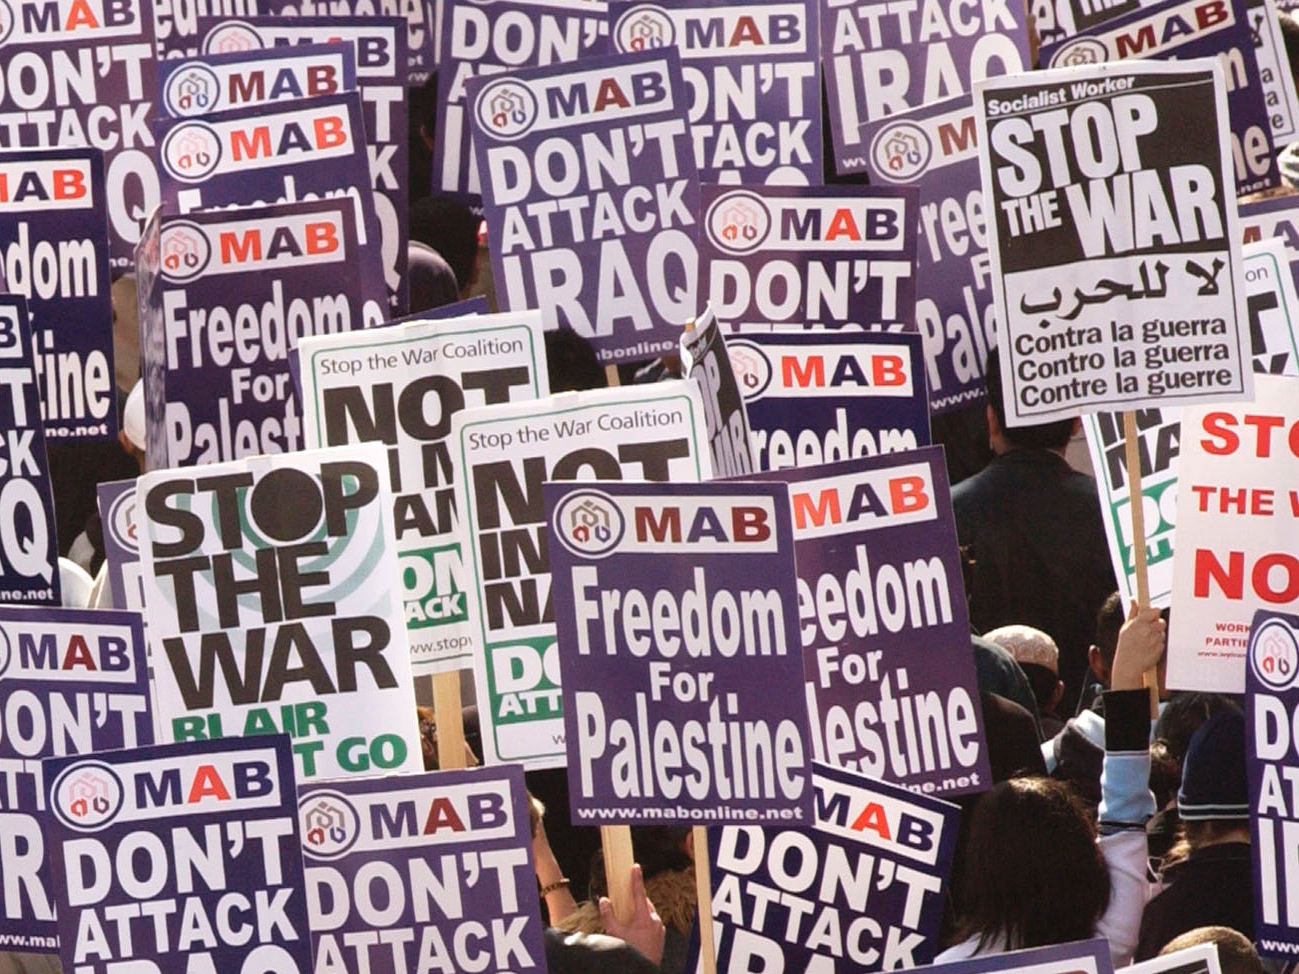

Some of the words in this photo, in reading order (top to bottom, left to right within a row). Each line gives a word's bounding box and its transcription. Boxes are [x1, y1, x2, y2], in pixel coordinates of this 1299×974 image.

[988, 88, 1065, 116] Socialist
[1072, 75, 1134, 99] Worker
[489, 119, 685, 206] DON'T
[991, 94, 1158, 198] STOP
[501, 179, 695, 253] ATTACK
[781, 209, 899, 241] MAB
[1001, 187, 1063, 237] THE
[1064, 164, 1224, 258] WAR
[219, 221, 339, 264] MAB
[710, 260, 910, 320] DON'T
[1019, 259, 1170, 331] للحرب
[1185, 257, 1225, 297] لا
[321, 355, 362, 377] Stop
[368, 350, 398, 369] the
[401, 345, 439, 366] War
[443, 337, 523, 359] Coalition
[1015, 323, 1100, 356] Contra
[1111, 317, 1134, 341] la
[1142, 315, 1227, 344] guerra
[781, 353, 907, 388] MAB
[1018, 352, 1104, 381] Contro
[1114, 344, 1136, 368] la
[1145, 340, 1230, 369] guerra
[1020, 378, 1107, 407] Contre
[1116, 372, 1139, 394] la
[1147, 367, 1233, 396] guerre
[469, 432, 513, 450] Stop
[516, 426, 550, 444] the
[554, 419, 593, 438] War
[597, 409, 683, 431] Coalition
[146, 461, 379, 557] STOP
[1192, 485, 1275, 516] THE
[154, 542, 335, 632] THE
[571, 565, 787, 656] Freedom
[19, 633, 128, 671] MAB
[162, 615, 399, 710] WAR
[818, 649, 883, 688] For
[650, 662, 714, 702] For
[337, 733, 407, 772] GO
[576, 691, 805, 800] Palestine
[135, 761, 273, 808] MAB
[371, 792, 508, 840] MAB
[578, 806, 806, 820] www.mabonline.net
[63, 818, 293, 906] DON'T
[306, 848, 528, 930] DON'T
[74, 888, 298, 963] ATTACK
